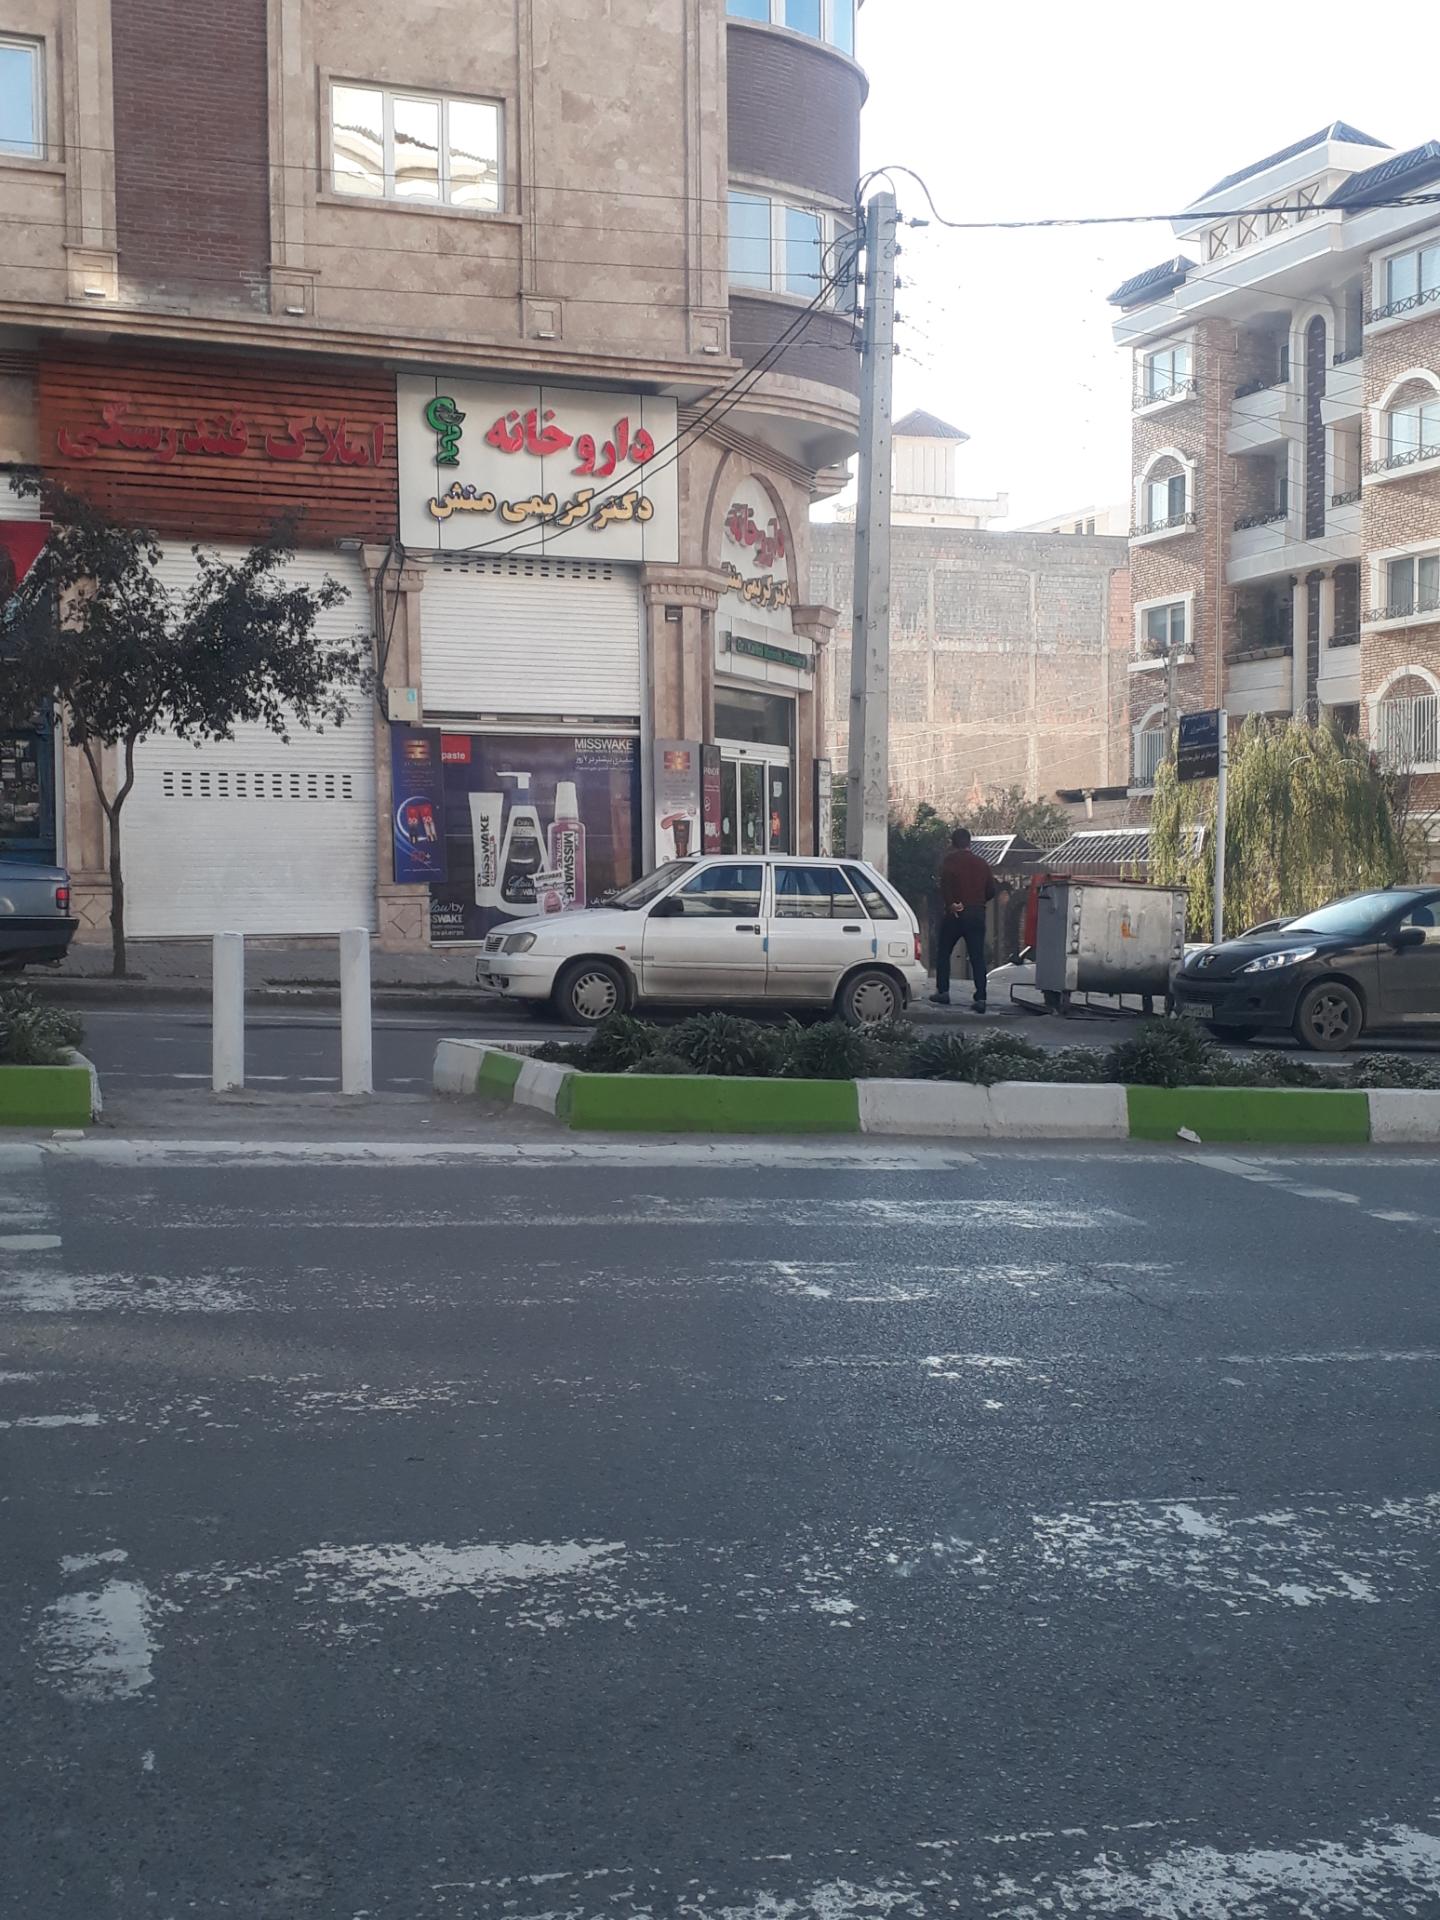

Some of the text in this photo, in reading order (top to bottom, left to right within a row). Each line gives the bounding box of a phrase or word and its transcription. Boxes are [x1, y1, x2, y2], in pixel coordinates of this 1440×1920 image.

[266, 415, 386, 466] املاک
[485, 408, 655, 477] داروخانه
[428, 481, 654, 531] دکتر کریمی منش
[725, 503, 785, 568] داروخانه
[441, 752, 466, 761] paste
[574, 738, 633, 750] MISSWAKE
[480, 815, 490, 888] MISSWAKE
